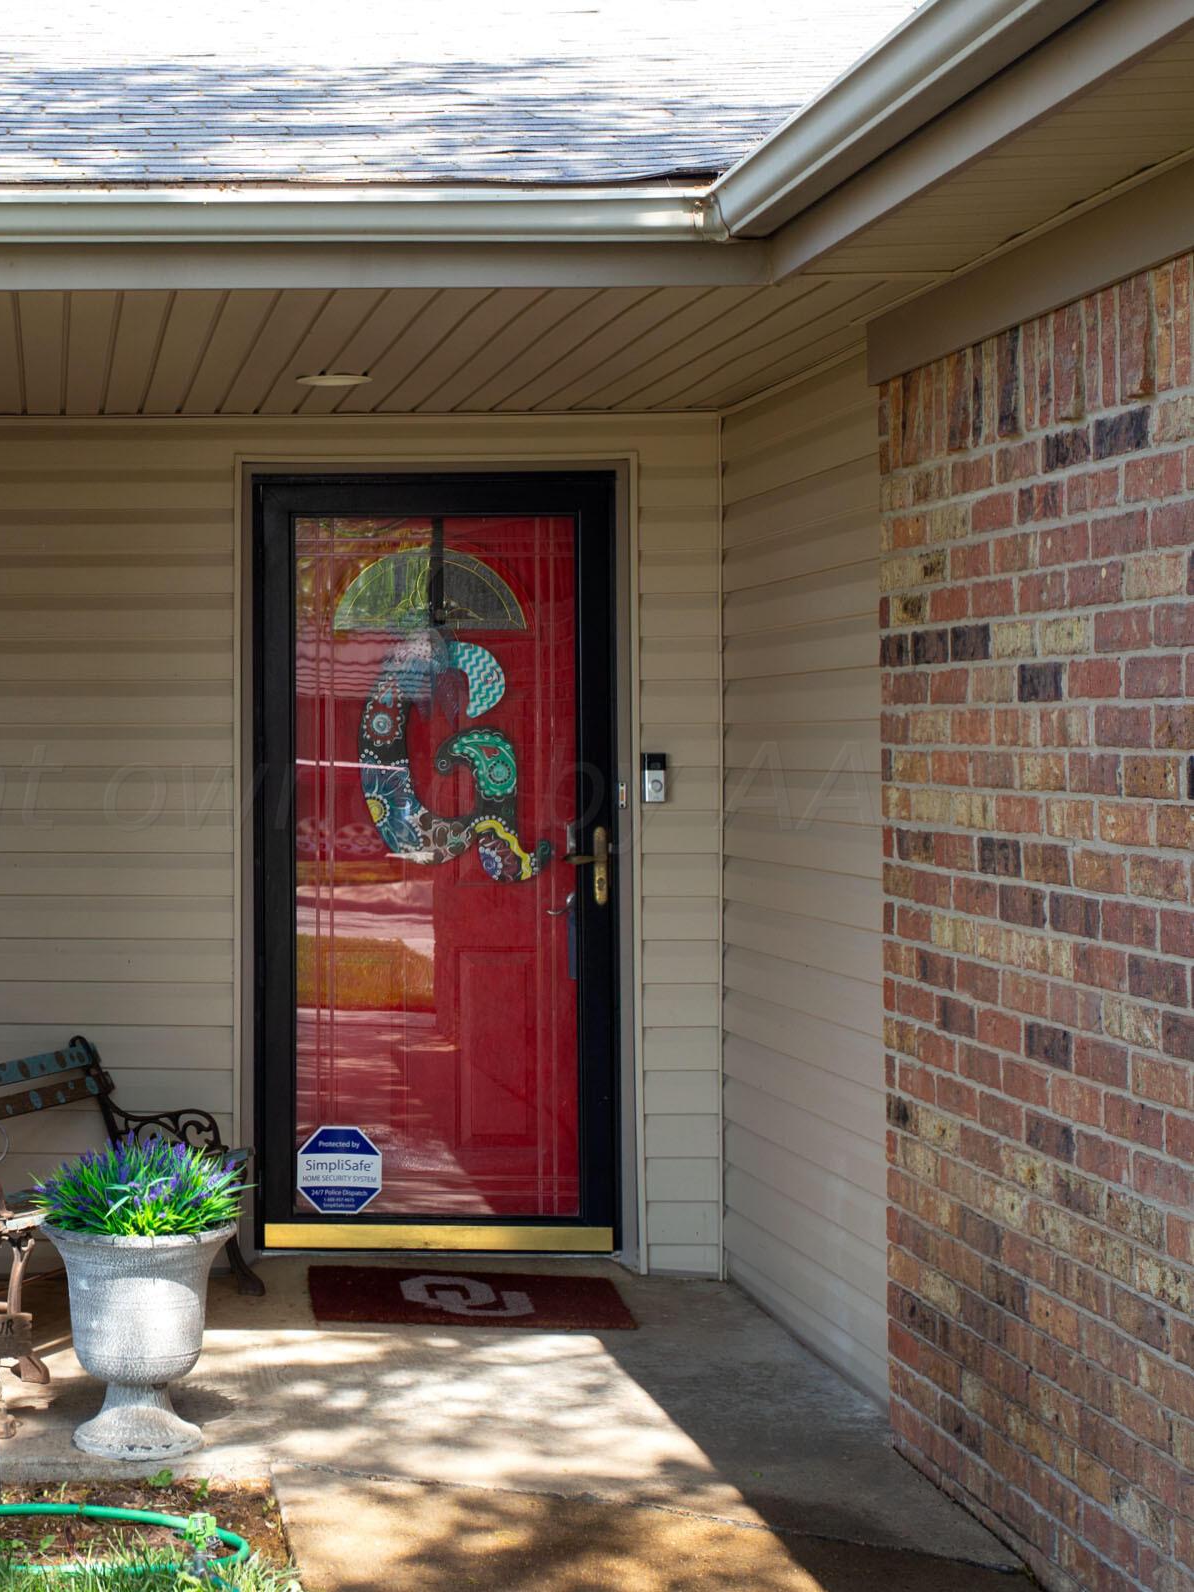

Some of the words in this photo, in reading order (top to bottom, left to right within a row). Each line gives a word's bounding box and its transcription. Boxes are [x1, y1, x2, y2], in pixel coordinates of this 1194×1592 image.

[352, 1141, 360, 1149] by
[305, 1159, 372, 1173] SimpliSafe
[342, 1189, 368, 1197] Dispatch
[399, 1274, 535, 1318] OU
